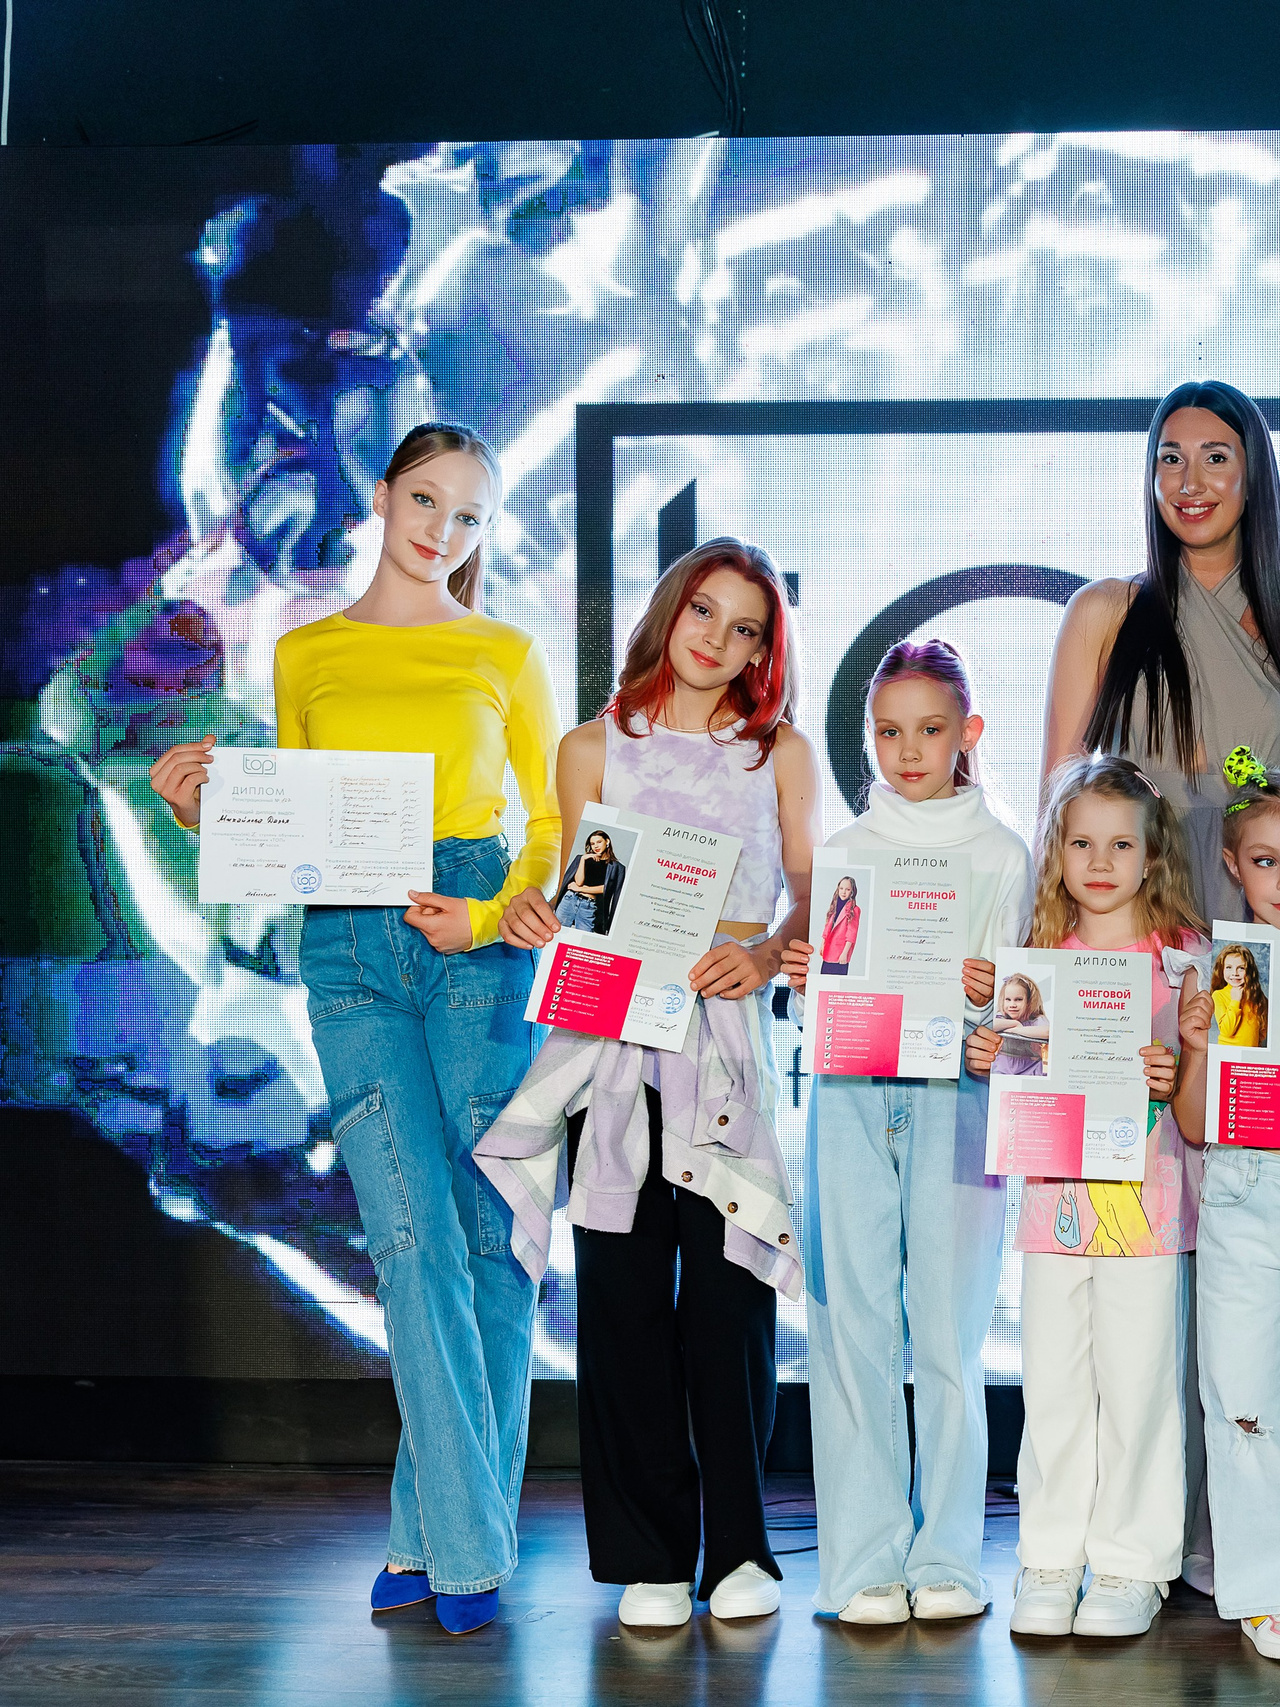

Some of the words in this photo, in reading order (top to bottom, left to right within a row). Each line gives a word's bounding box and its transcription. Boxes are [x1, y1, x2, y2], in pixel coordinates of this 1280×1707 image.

[245, 756, 274, 775] top
[232, 786, 284, 796] ДИПЛОМ
[662, 826, 718, 846] ДИПЛОМ
[894, 857, 948, 868] ДИПЛОМ
[657, 858, 716, 879] ЧАКАЛЕВОЙ
[666, 872, 698, 886] АРИНЕ
[890, 890, 956, 900] ШУРЫГИНОЙ
[908, 901, 937, 910] ЕЛЕНЕ
[1074, 956, 1128, 966] ДИПЛОМ
[1078, 989, 1131, 999] ОНЕГОВОЙ
[633, 993, 656, 1008] top
[1083, 1000, 1125, 1010] МИЛАНЕ
[903, 1028, 924, 1040] top
[1086, 1129, 1107, 1142] top
